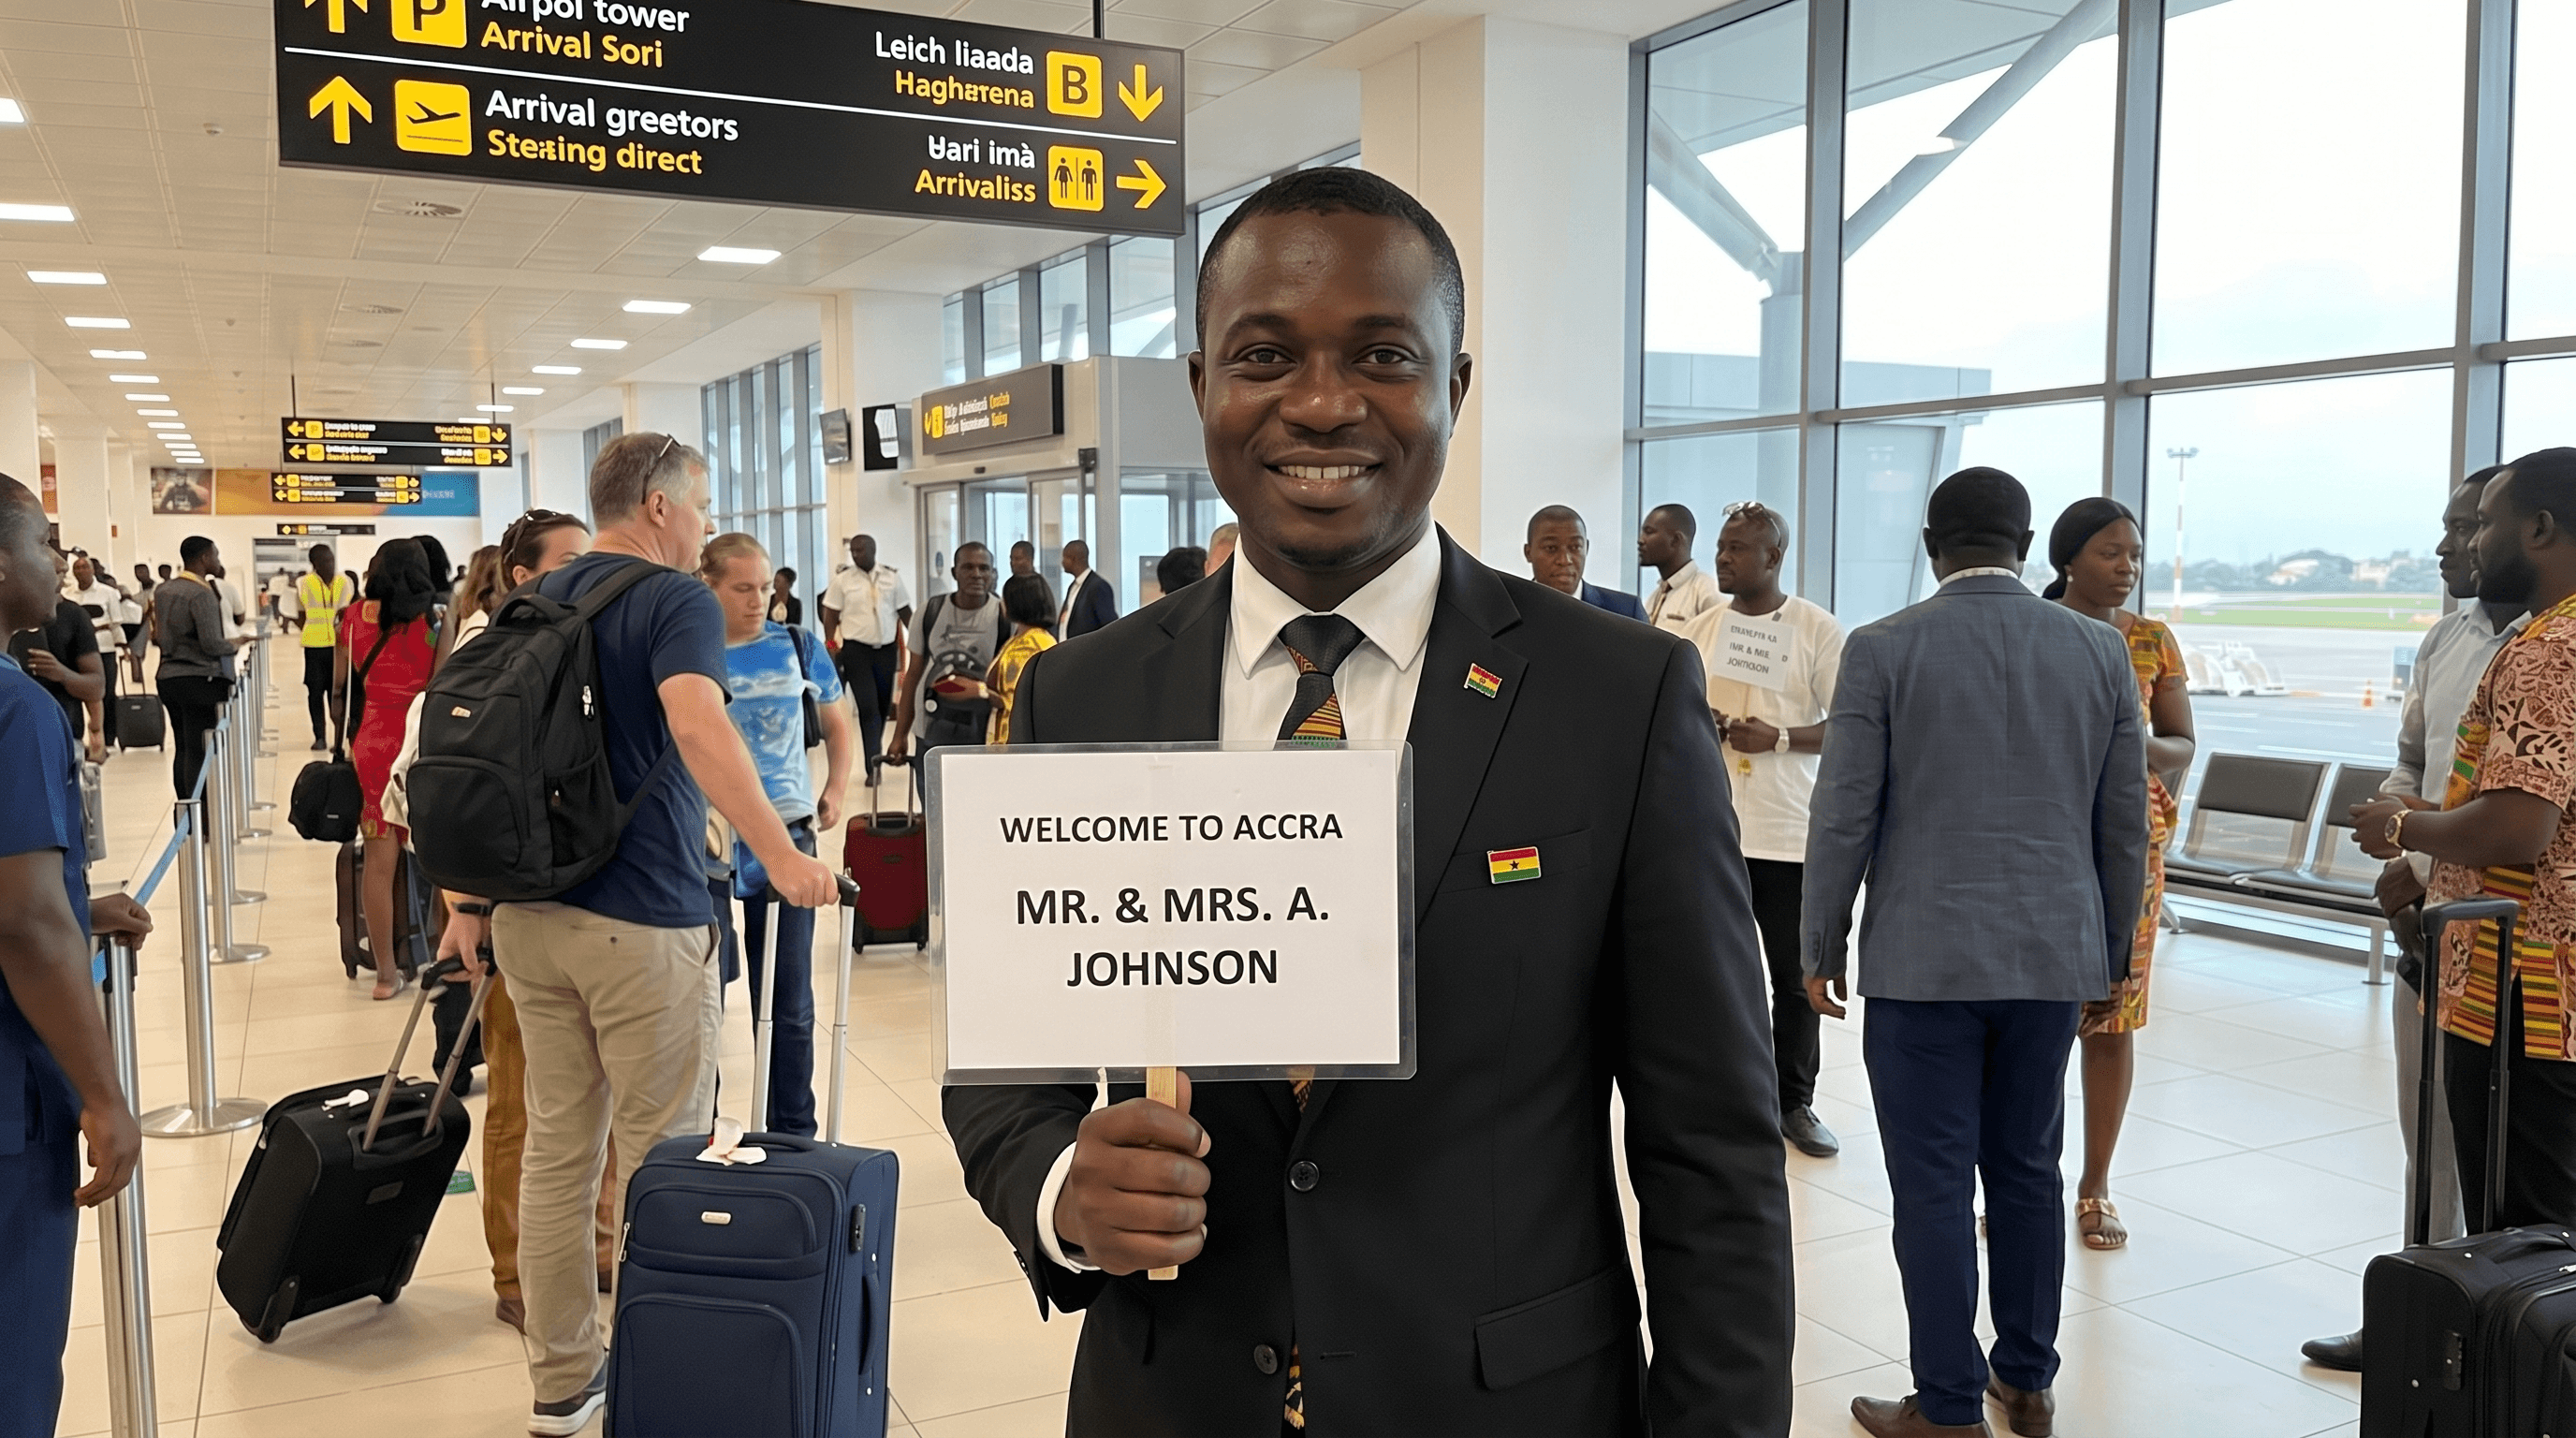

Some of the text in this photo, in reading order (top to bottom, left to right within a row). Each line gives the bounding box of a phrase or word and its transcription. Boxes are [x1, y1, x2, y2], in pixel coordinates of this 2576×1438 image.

[593, 0, 689, 32] tower
[481, 22, 662, 67] Arrival Sori
[876, 32, 945, 64] Leich
[486, 90, 738, 140] Arrival greetors
[617, 142, 702, 174] direct
[915, 169, 1035, 202] Arrivaliss
[1001, 814, 1342, 842] WELCOME TO ACCRA
[1017, 888, 1327, 924] MR. & MRS. A.
[1068, 950, 1276, 986] JOHNSON
